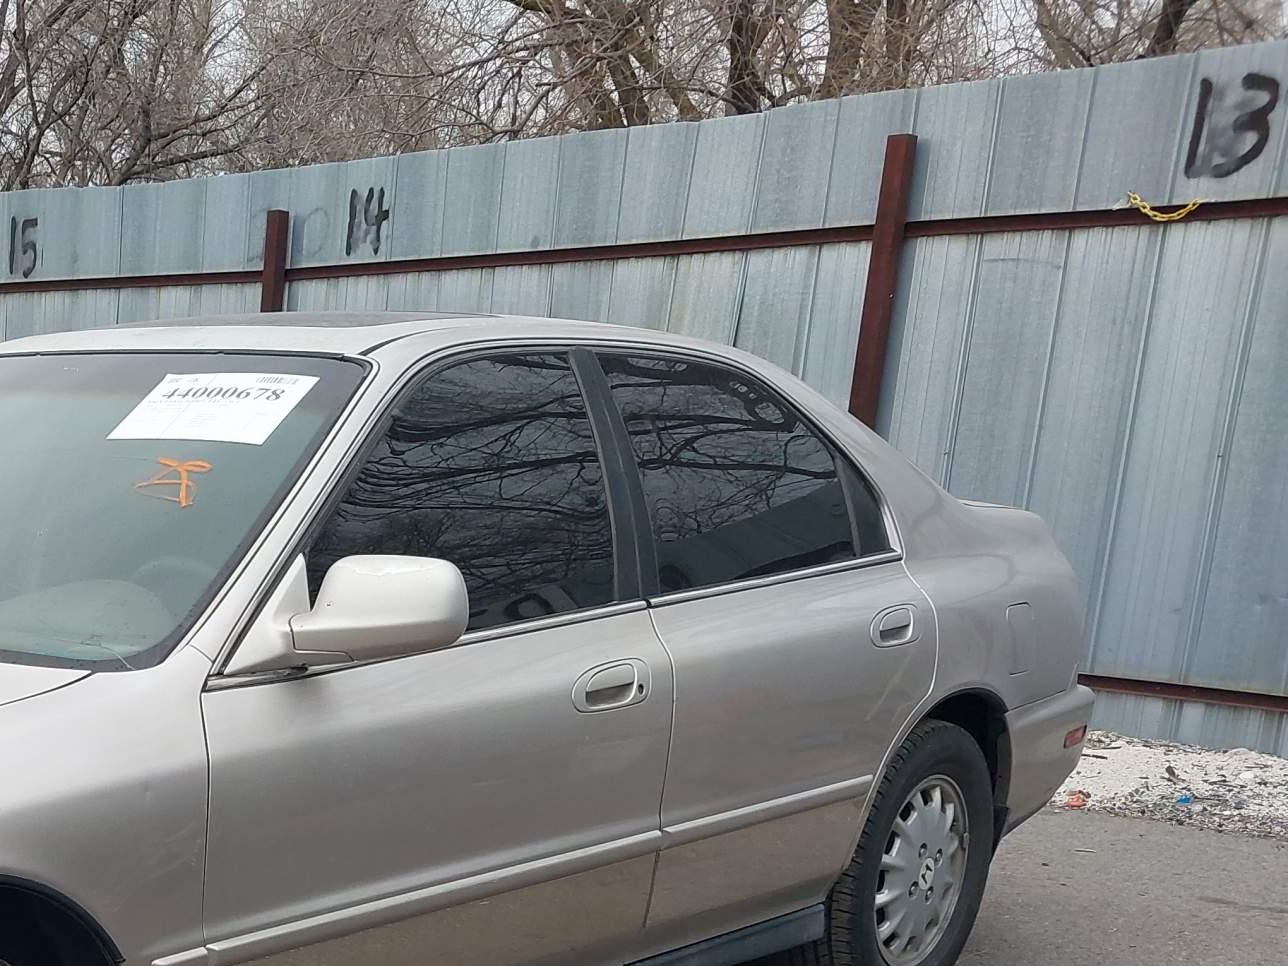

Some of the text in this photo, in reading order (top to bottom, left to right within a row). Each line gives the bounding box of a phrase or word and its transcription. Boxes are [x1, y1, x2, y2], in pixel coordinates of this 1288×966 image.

[1184, 72, 1281, 179] 13
[9, 215, 38, 279] 15
[345, 186, 391, 257] 14
[162, 386, 286, 401] 44000678
